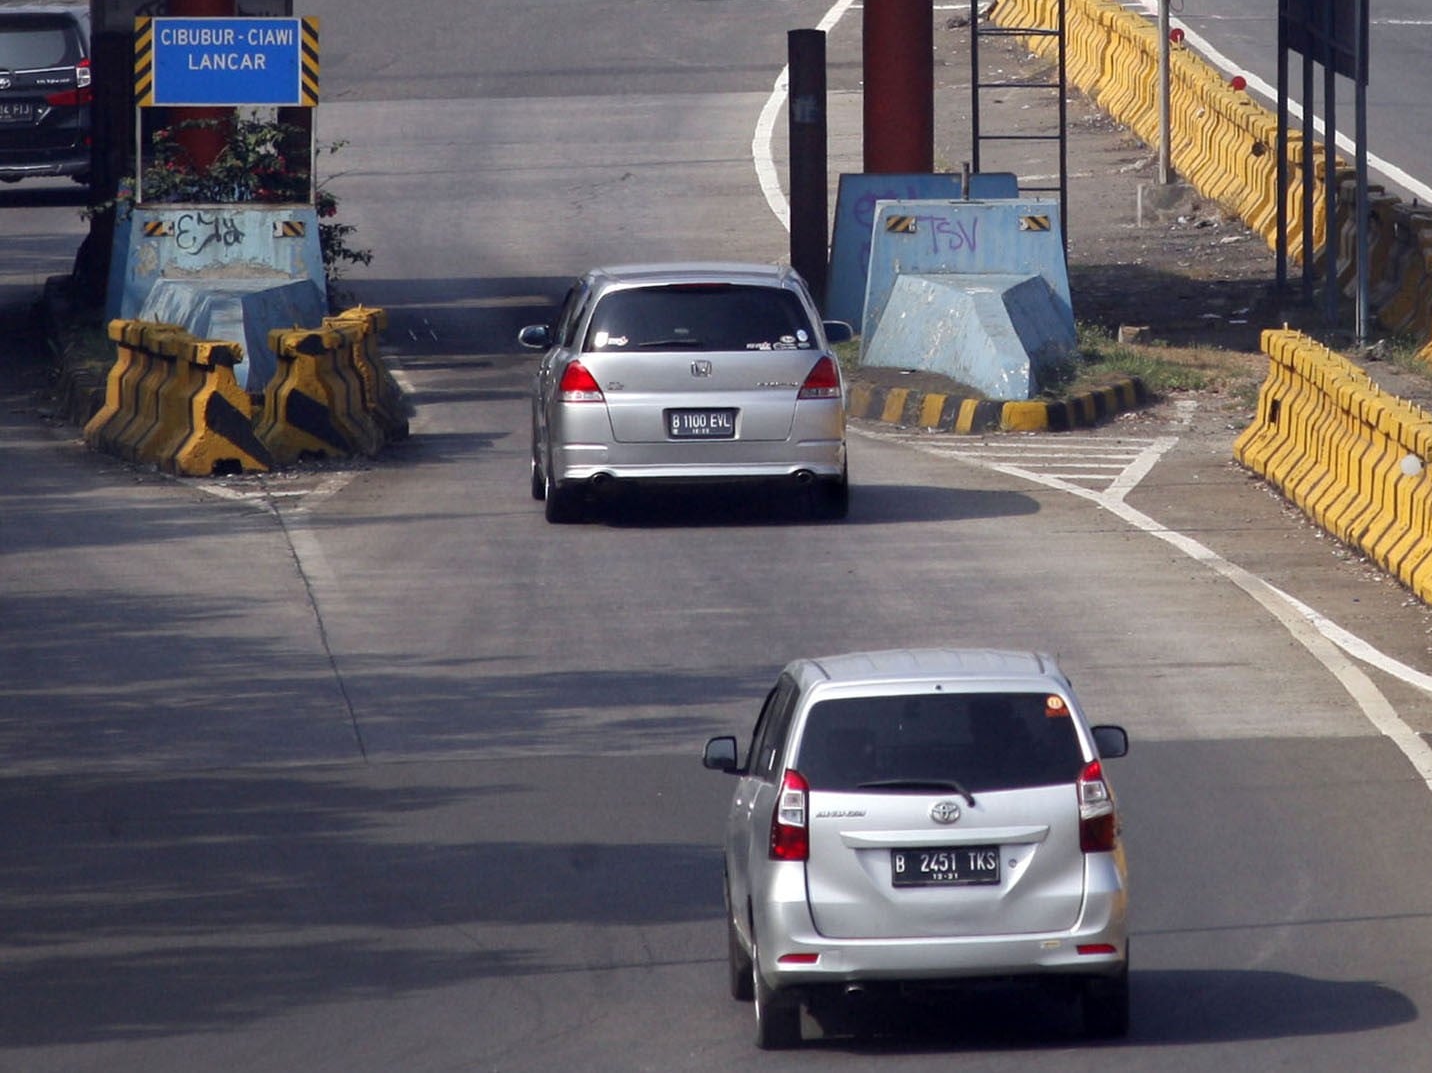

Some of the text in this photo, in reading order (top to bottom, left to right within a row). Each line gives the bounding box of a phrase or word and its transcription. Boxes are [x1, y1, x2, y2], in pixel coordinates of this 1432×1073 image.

[160, 28, 235, 46] CIBUBUR
[247, 28, 293, 46] CIAWI
[188, 53, 267, 70] LANCAR
[673, 413, 731, 428] B 1100 EVL
[896, 851, 996, 873] B 2451 TKS
